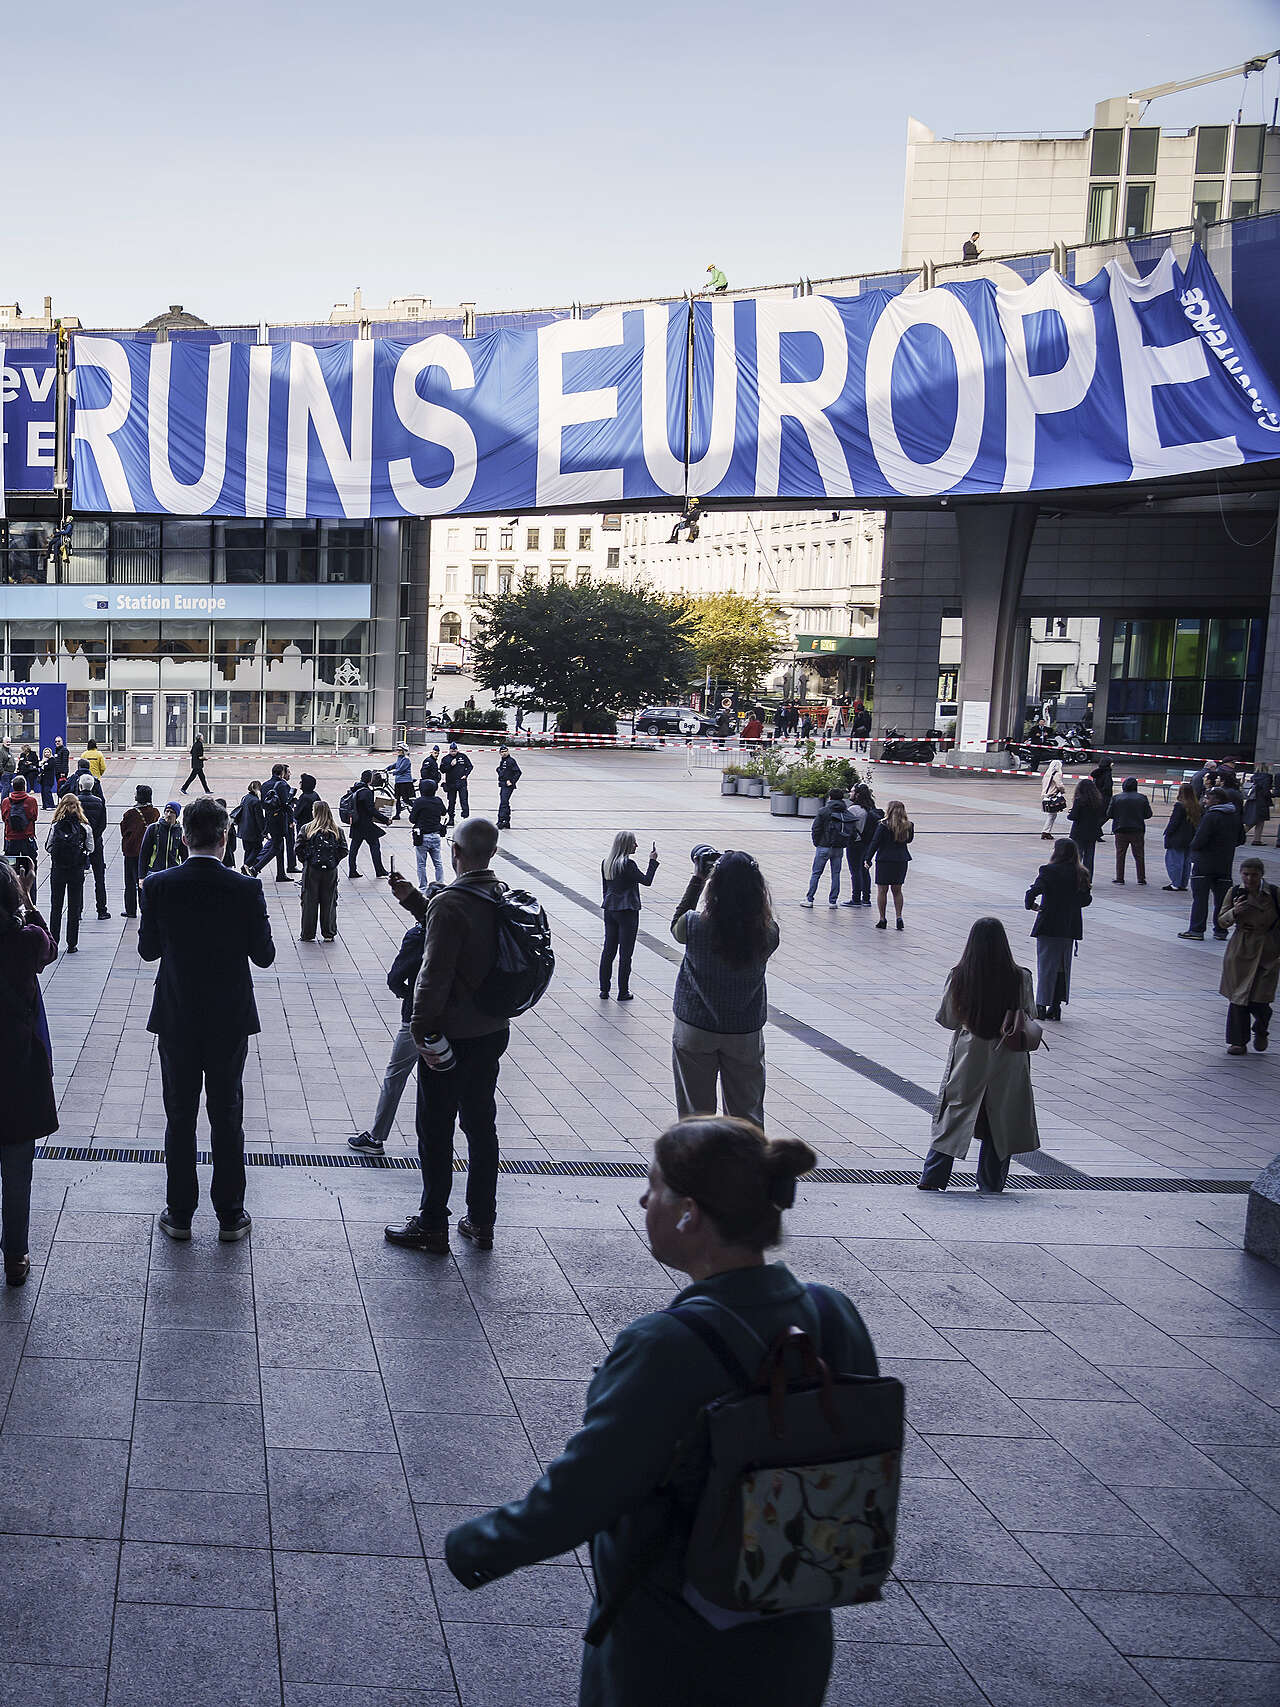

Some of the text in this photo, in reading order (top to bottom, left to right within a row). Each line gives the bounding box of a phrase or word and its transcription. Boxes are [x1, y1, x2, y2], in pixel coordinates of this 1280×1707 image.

[536, 247, 1245, 507] EUROPE
[116, 594, 226, 613] Station Europe
